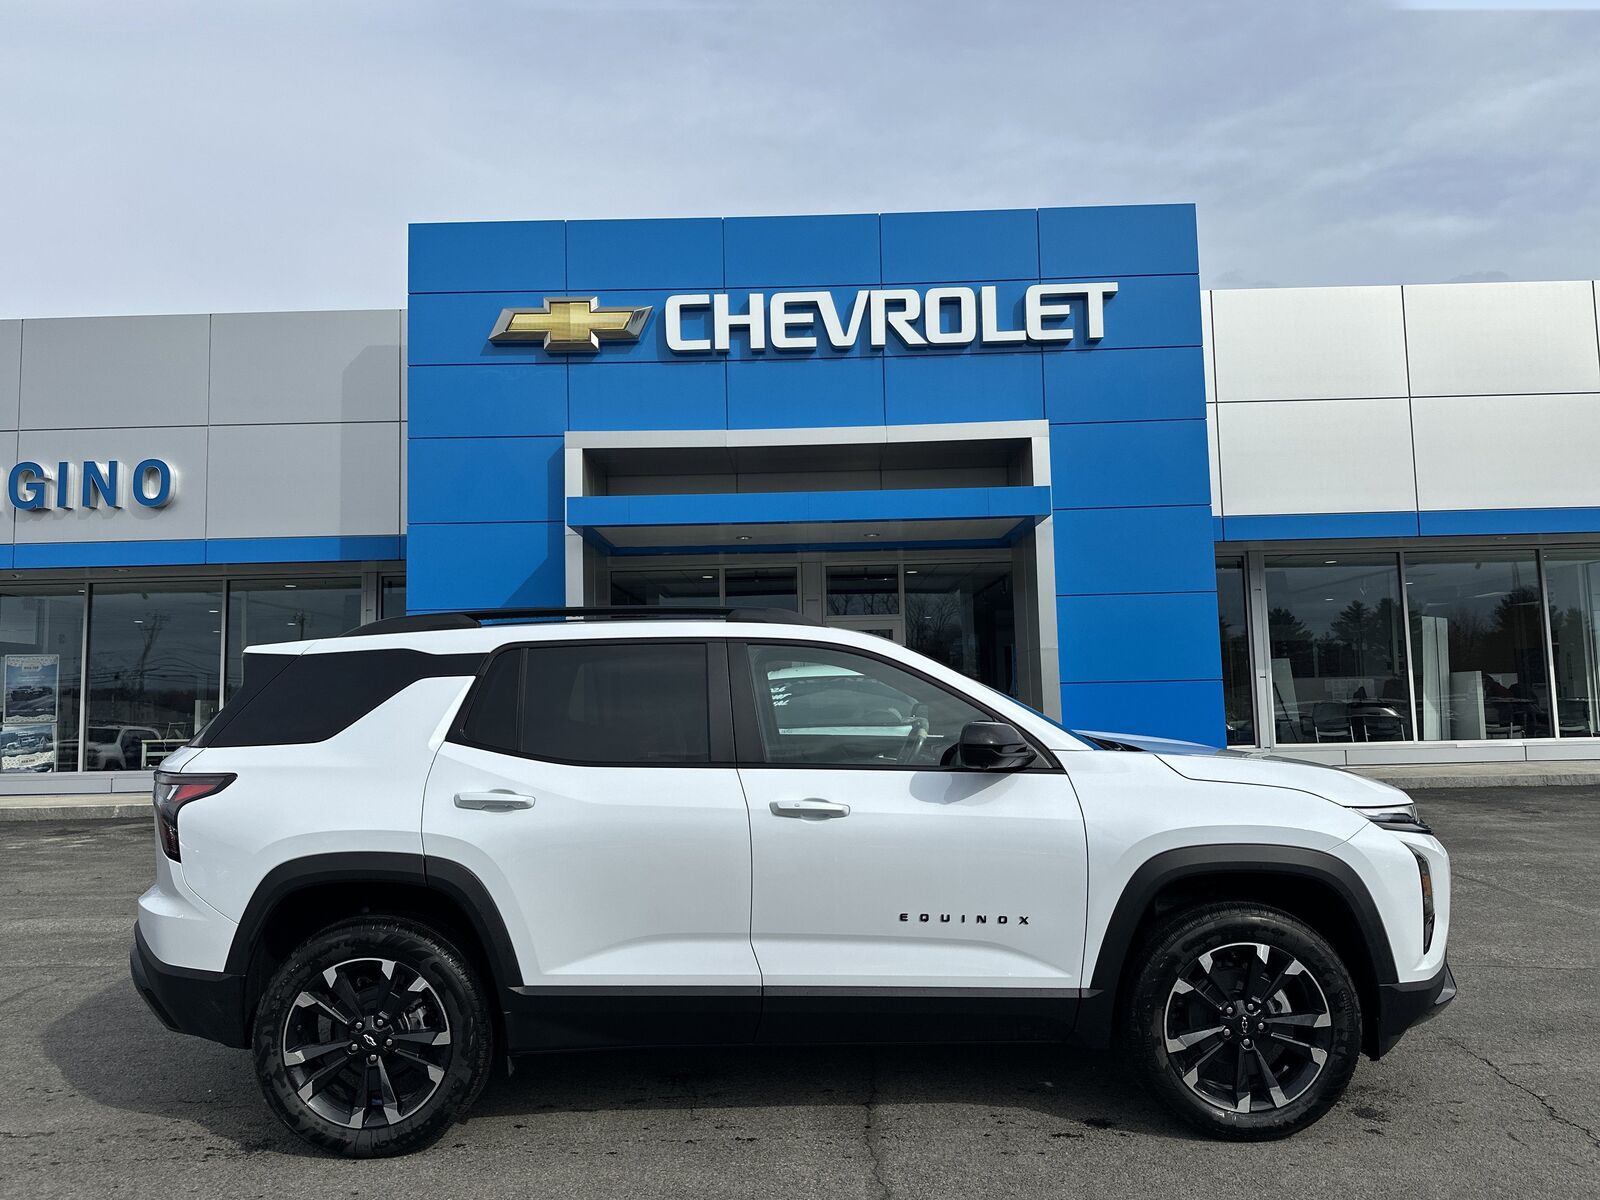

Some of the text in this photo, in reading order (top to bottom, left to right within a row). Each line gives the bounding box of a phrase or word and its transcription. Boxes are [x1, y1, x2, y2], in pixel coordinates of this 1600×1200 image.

[665, 282, 1119, 351] CHEVROLET
[7, 458, 175, 511] GINO
[899, 912, 1029, 925] EQUINOX
